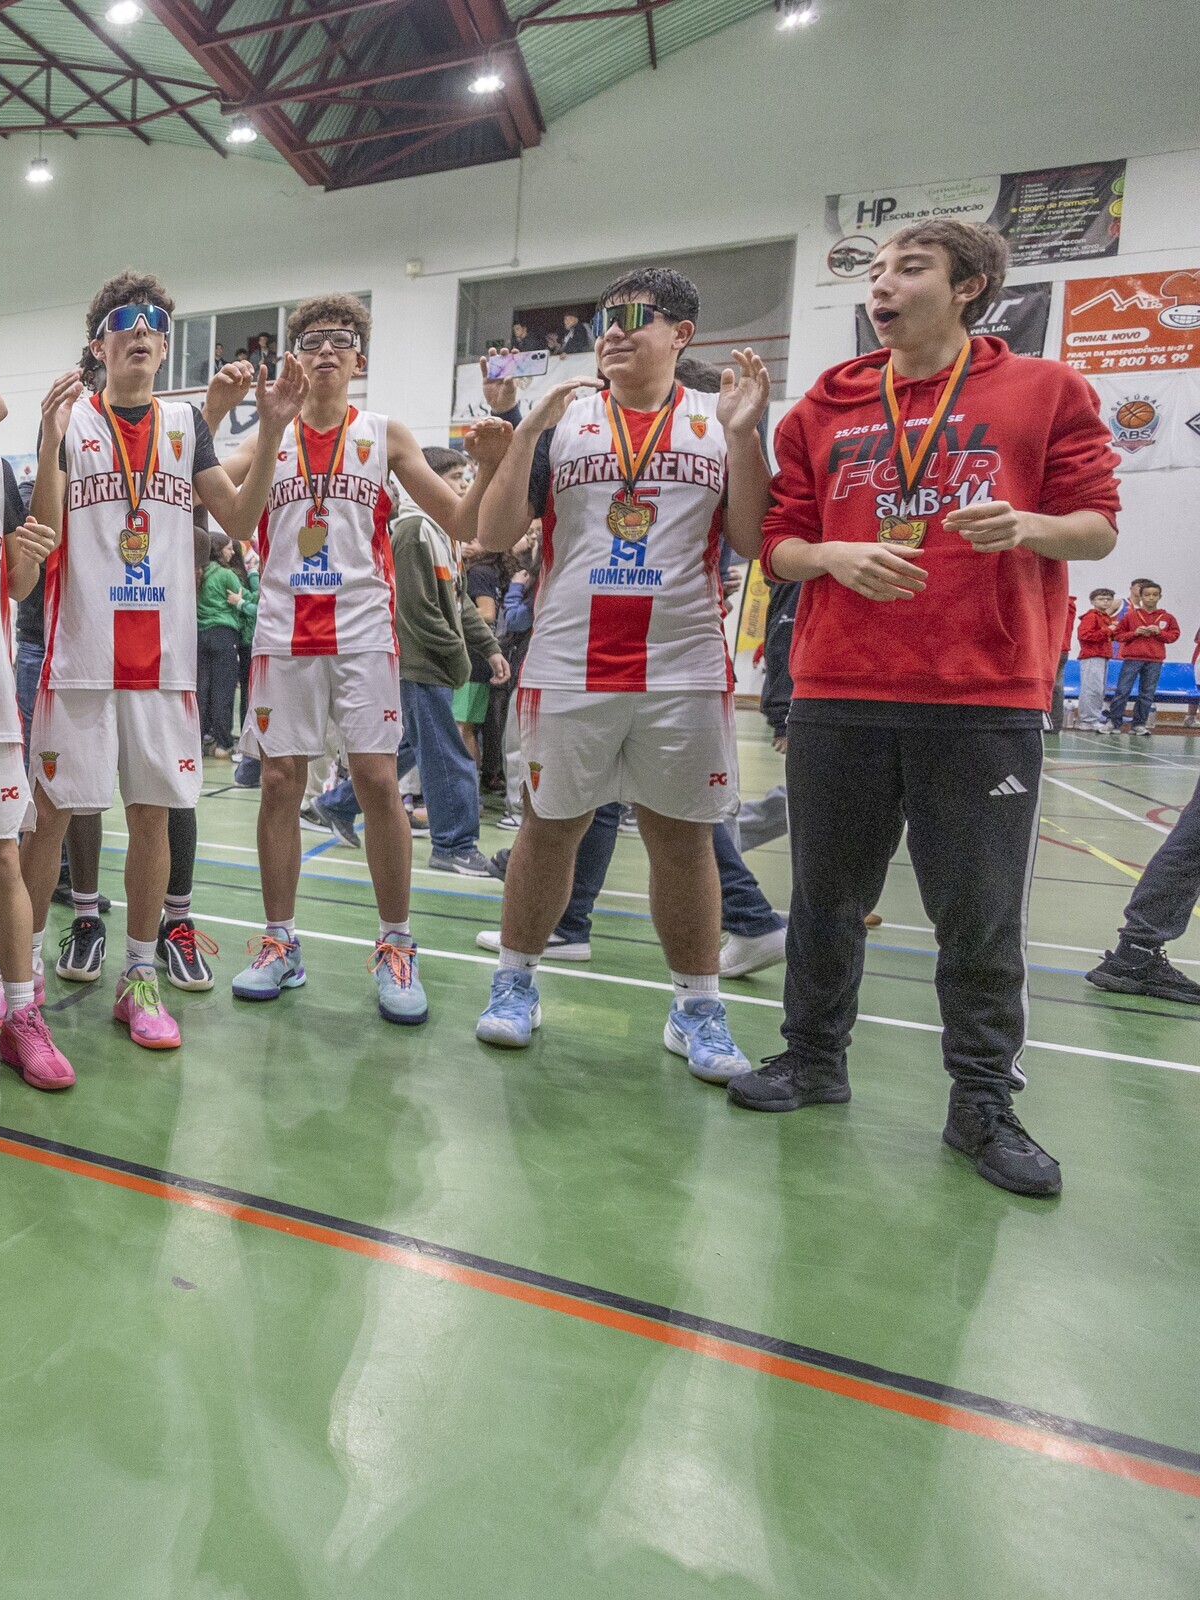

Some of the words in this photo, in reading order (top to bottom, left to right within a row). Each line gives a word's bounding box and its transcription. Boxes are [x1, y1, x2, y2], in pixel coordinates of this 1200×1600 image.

[917, 209, 930, 217] de
[1018, 204, 1045, 214] Centro
[1072, 333, 1108, 343] PINHAL
[1111, 331, 1142, 341] NOVO
[1066, 351, 1092, 359] PRAÇA
[1093, 349, 1105, 357] DA
[1105, 345, 1166, 356] INDEPENDÊNCIA
[1100, 358, 1115, 368] 21
[1117, 356, 1146, 367] 800
[1150, 354, 1167, 364] 96
[1171, 352, 1190, 363] 99
[1111, 393, 1162, 412] SETÚBAL
[834, 424, 868, 439] 25/26
[1117, 430, 1151, 440] ABS
[289, 572, 343, 587] HOMEWORK
[588, 568, 663, 586] HOMEWORK
[109, 586, 166, 602] HOMEWORK
